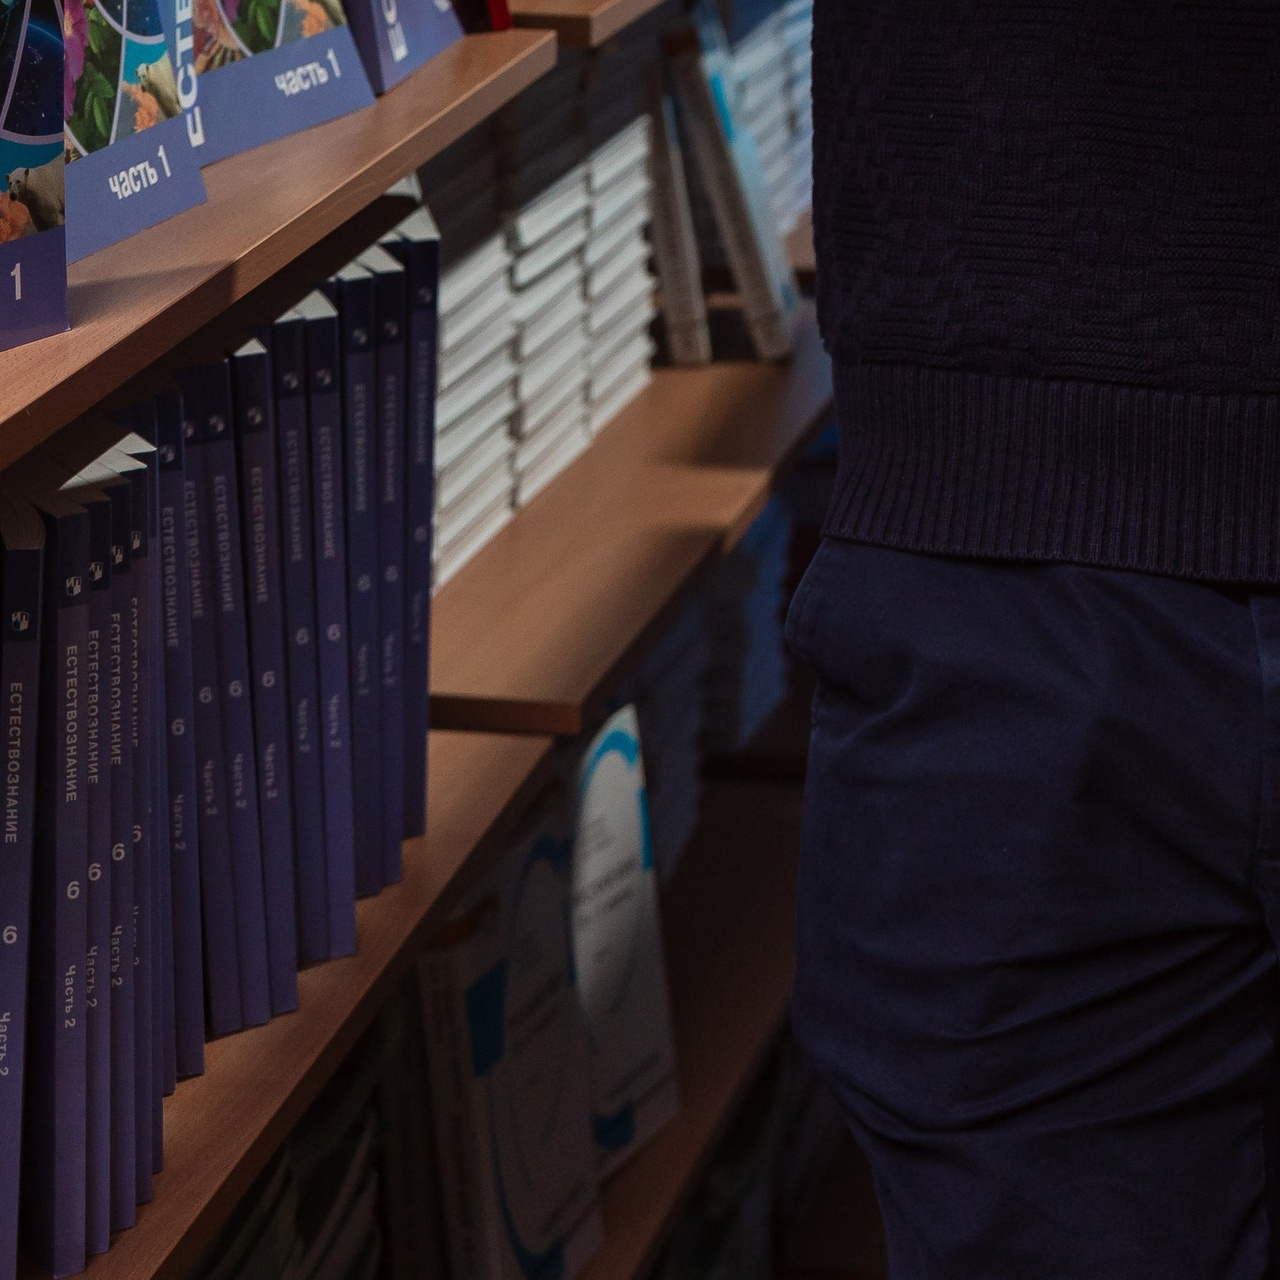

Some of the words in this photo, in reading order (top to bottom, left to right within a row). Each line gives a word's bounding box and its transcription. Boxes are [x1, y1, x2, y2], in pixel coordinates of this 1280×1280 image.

[275, 61, 328, 97] часть
[327, 48, 341, 78] 1
[108, 159, 159, 201] часть
[157, 144, 172, 178] 1
[10, 262, 22, 301] 1
[184, 480, 204, 619] ЕСТЕСТВОЗНАНИЕ
[213, 474, 235, 613] ЕСТЕСТВОЗНАНИЕ
[251, 466, 269, 604] ЕСТЕСТВОЗНАНИЕ
[162, 506, 179, 648] ЕСТЕСТВОЗНАНИЕ
[88, 629, 100, 785] ЕСТЕСТВОЗНАНИЕ
[110, 612, 122, 767] ЕСТЕСТВОЗНАНИЕ
[65, 644, 78, 804] ЕСТЕСТВОЗНАНИЕ
[170, 716, 186, 736] 6
[4, 682, 23, 844] ЕСТЕСТВОЗНАНИЕ
[87, 862, 102, 882] 6
[111, 842, 126, 862] 6
[66, 881, 80, 900] 6
[2, 924, 18, 944] 6
[111, 924, 123, 976] Часть
[65, 965, 76, 1015] Часть
[86, 945, 98, 994] Часть
[112, 976, 123, 988] 2
[65, 1017, 76, 1029] 2
[86, 997, 97, 1009] 2
